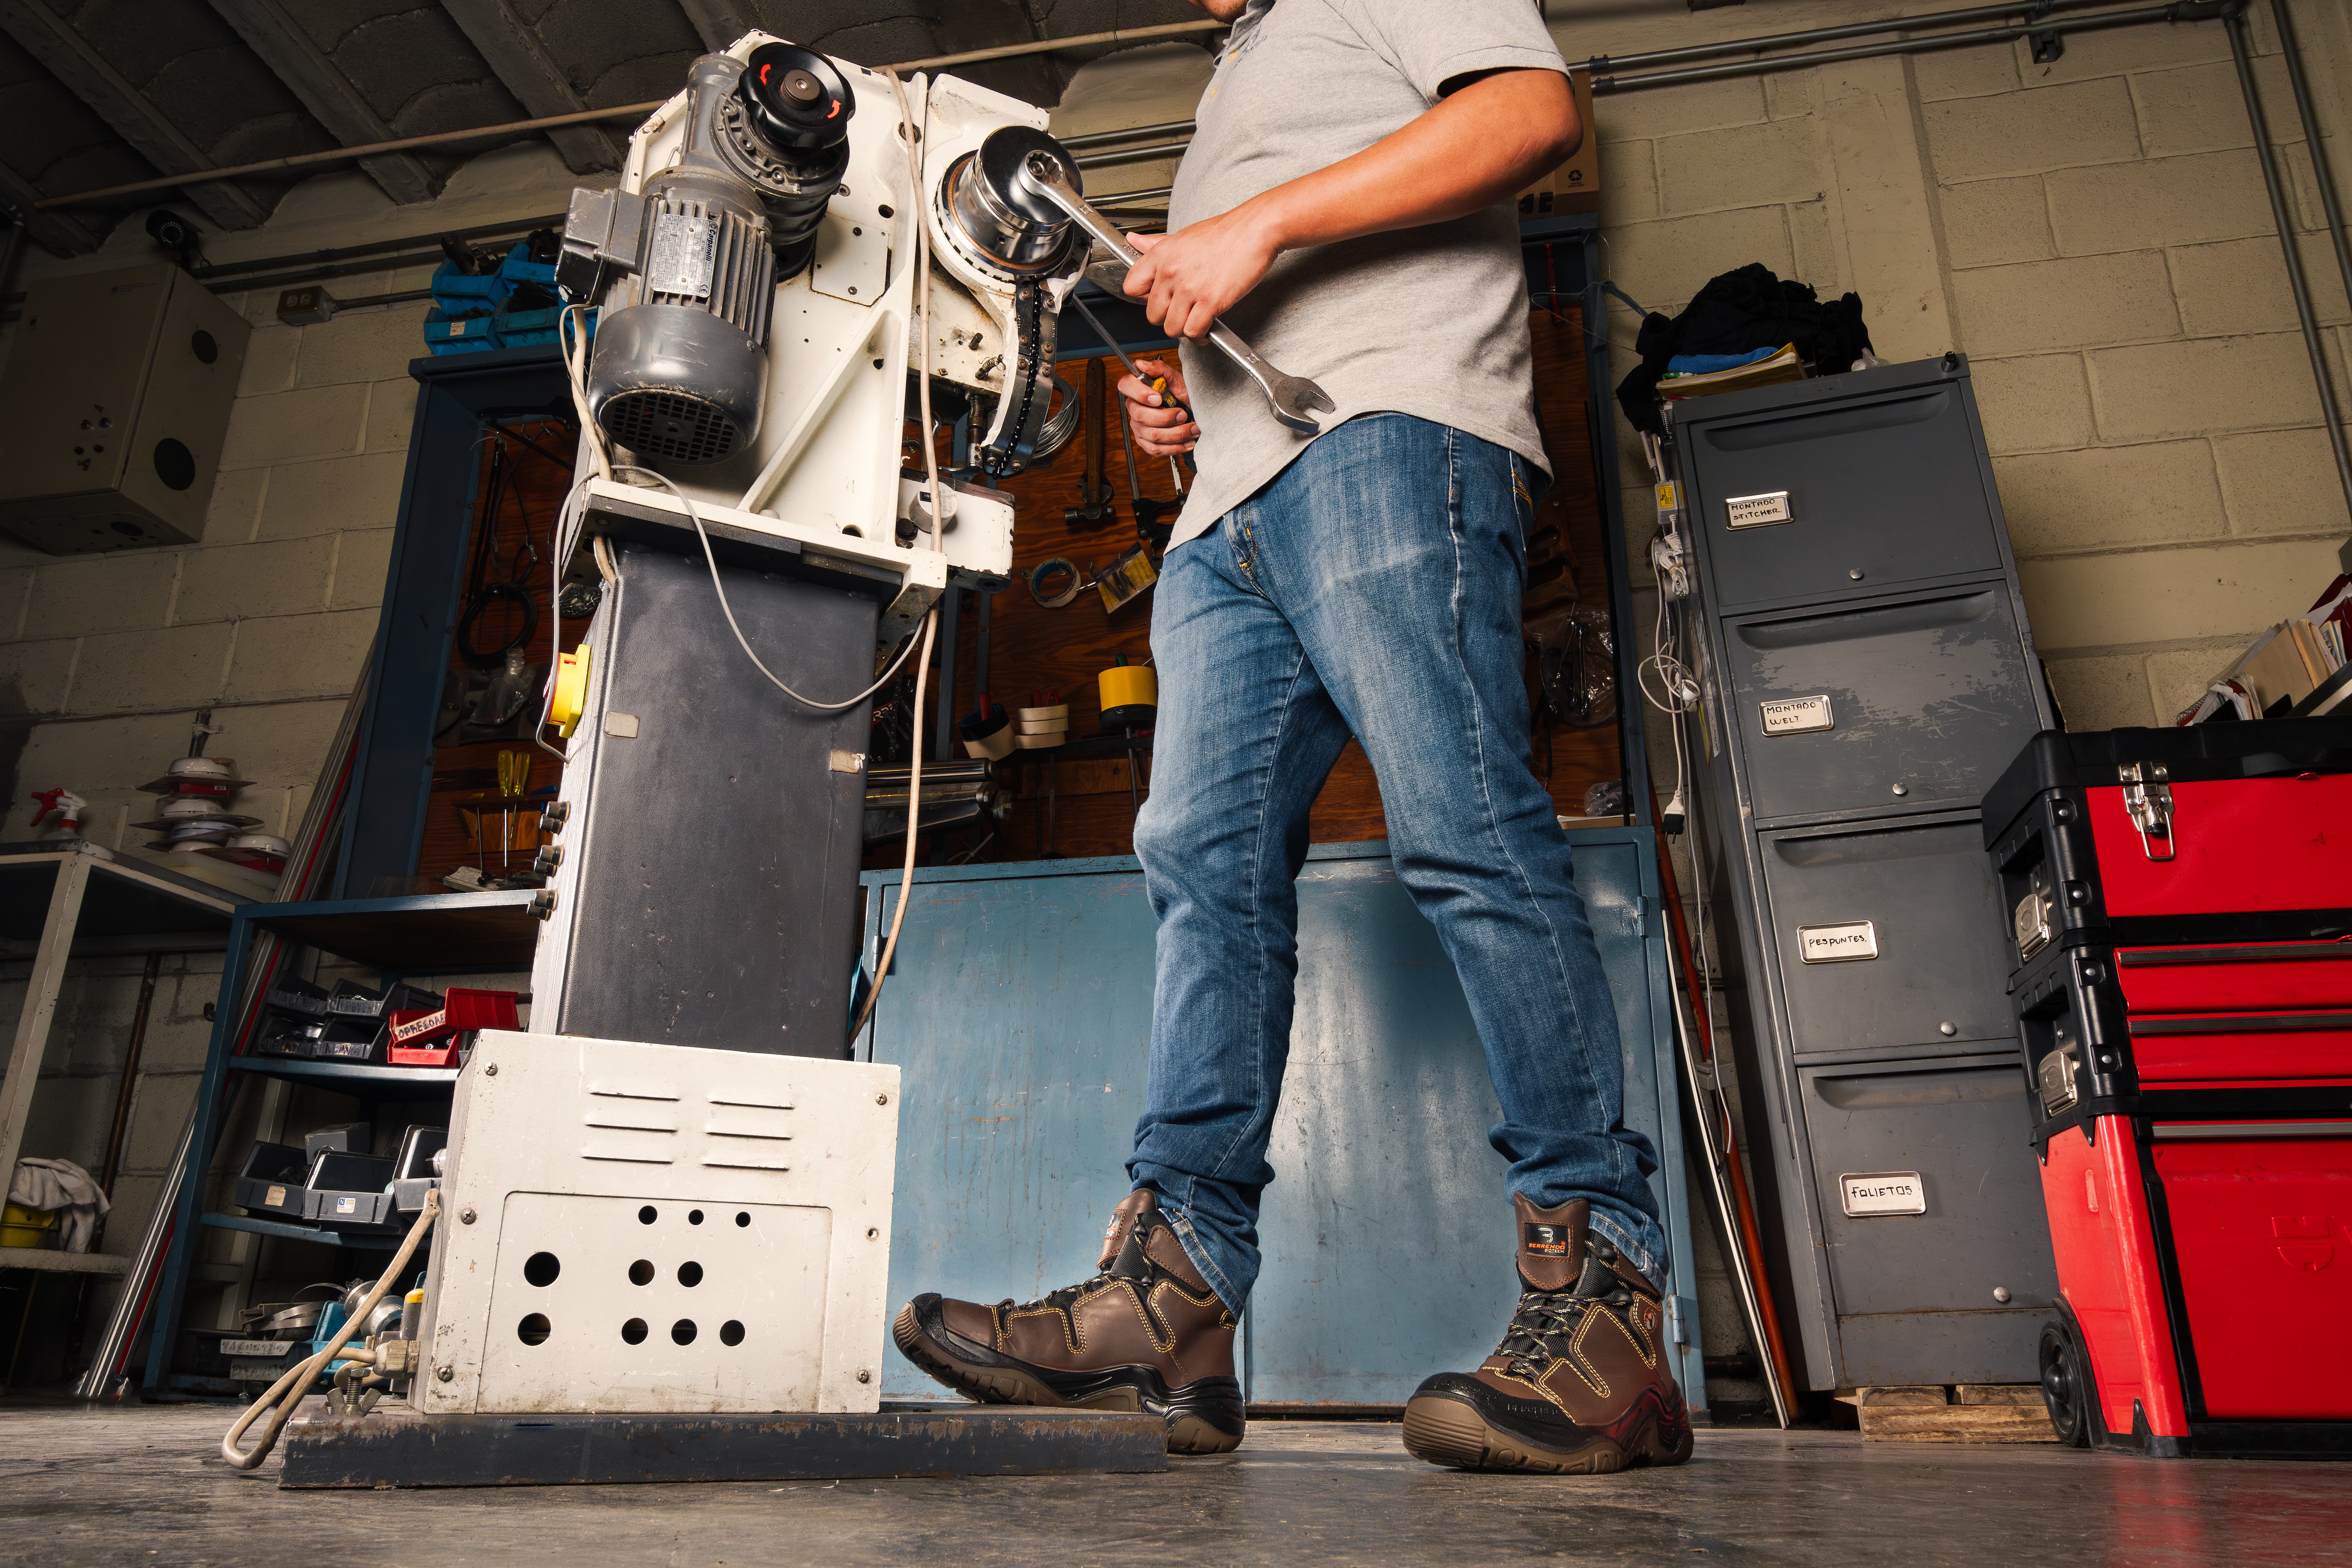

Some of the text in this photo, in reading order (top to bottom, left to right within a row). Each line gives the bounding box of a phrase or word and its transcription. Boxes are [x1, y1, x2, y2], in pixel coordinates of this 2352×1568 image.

[705, 230, 716, 262] Carpanelli
[1731, 499, 1775, 510] MONTADO
[1767, 702, 1816, 714] MONTADO
[1809, 935, 1867, 947] PESPUNTES.
